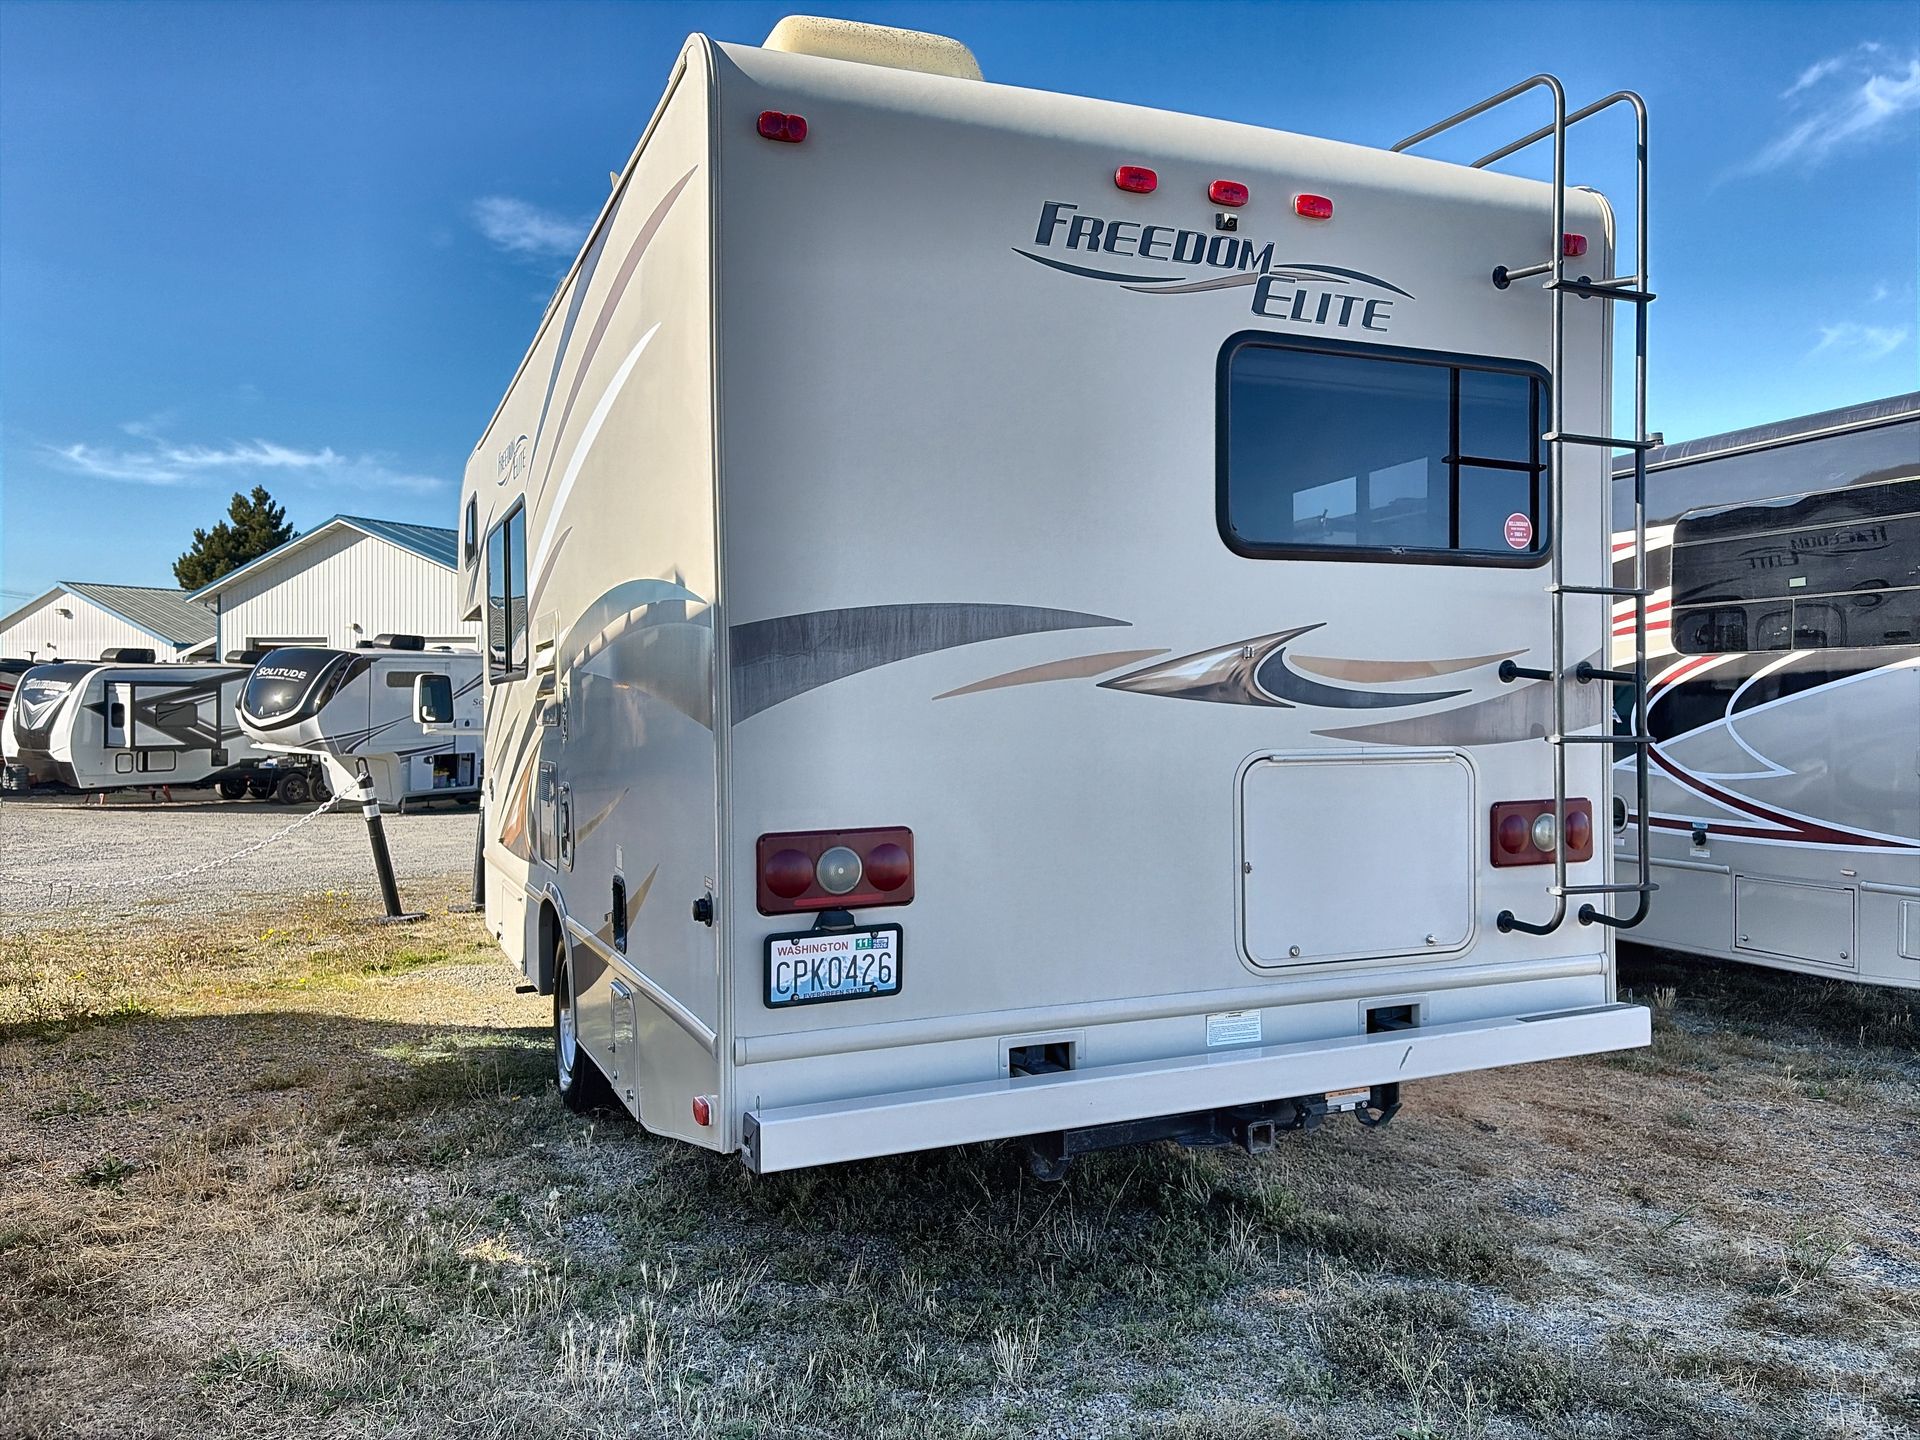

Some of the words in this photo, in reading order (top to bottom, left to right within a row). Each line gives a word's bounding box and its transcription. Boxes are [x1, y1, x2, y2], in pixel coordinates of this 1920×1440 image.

[1034, 201, 1275, 274] FREEDOM
[1251, 273, 1394, 332] ELITE
[256, 666, 308, 680] SOLITUDE
[777, 941, 849, 957] WASHINGTON
[776, 952, 892, 995] CPK0426
